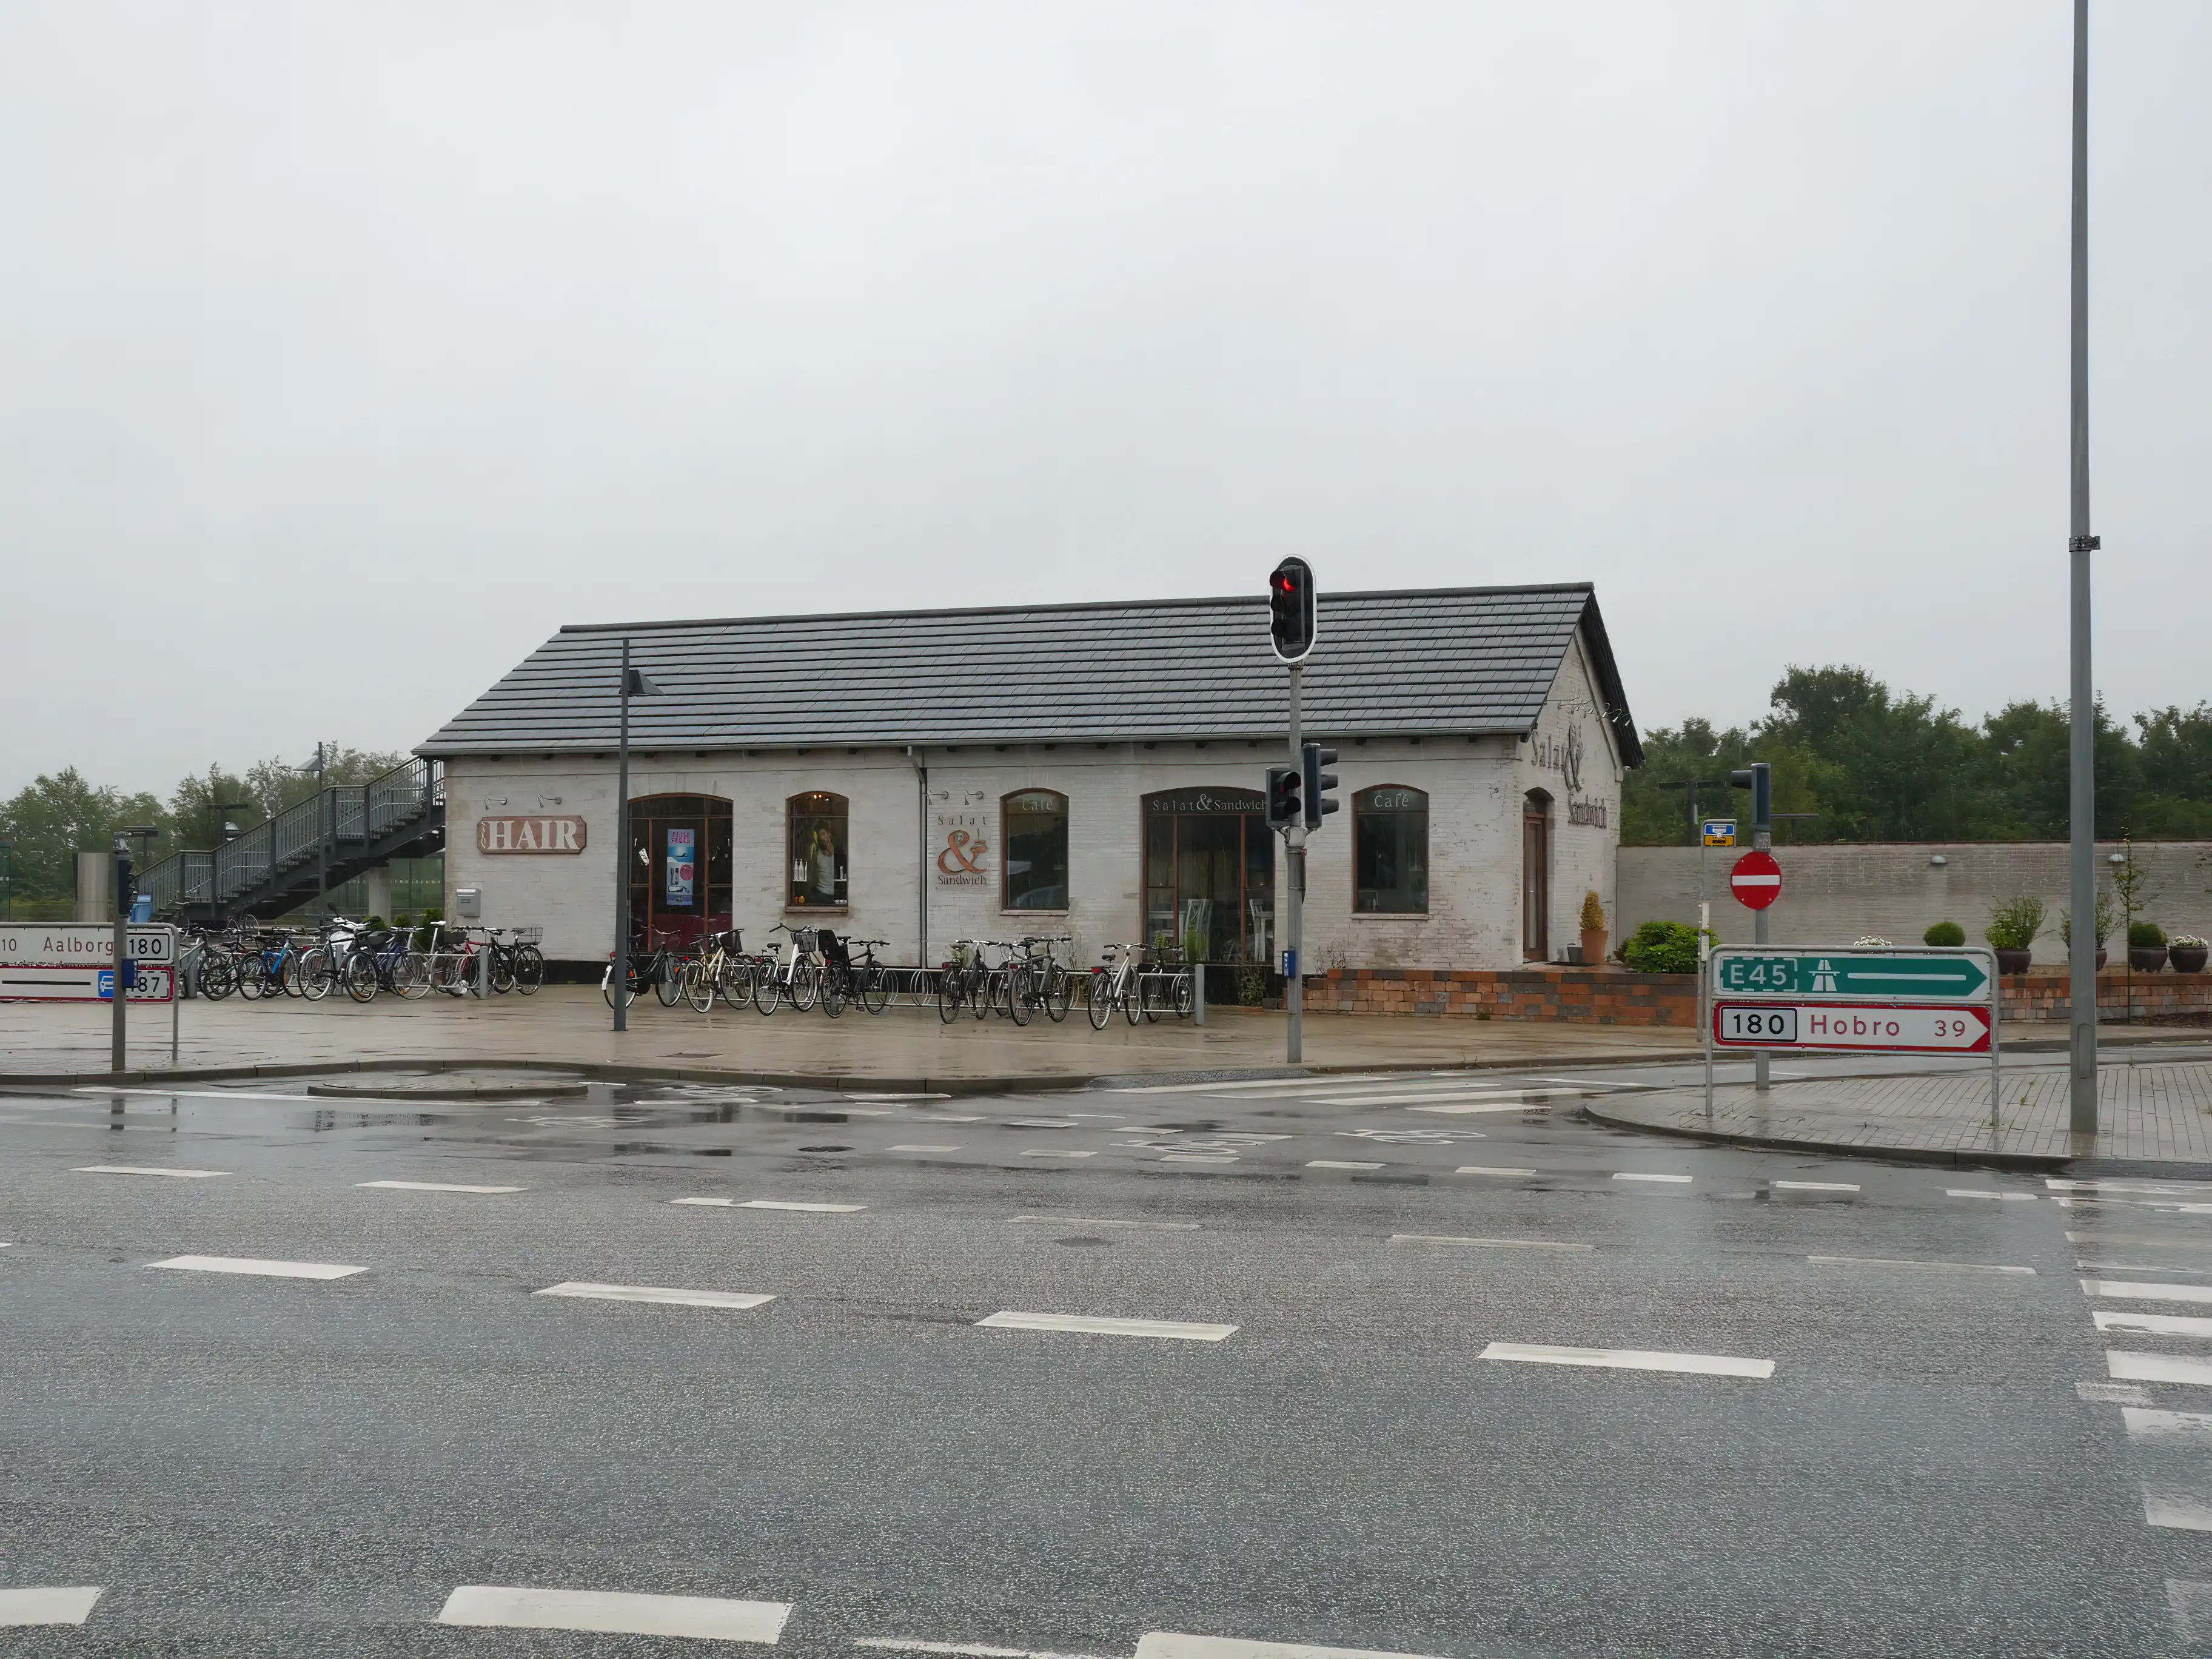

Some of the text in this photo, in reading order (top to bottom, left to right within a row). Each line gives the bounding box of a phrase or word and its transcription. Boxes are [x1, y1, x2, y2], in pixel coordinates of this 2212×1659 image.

[1153, 800, 1194, 811] Salat
[1196, 794, 1213, 810] &
[1375, 793, 1409, 808] Café
[938, 815, 987, 825] Salat
[482, 820, 580, 850] HAIR
[938, 875, 987, 885] Sandwich
[2, 937, 162, 956] 10 Aalborg 180
[1730, 964, 1787, 985] E45
[130, 976, 160, 993] 87
[1733, 1014, 1966, 1037] 180 Hobro 39
